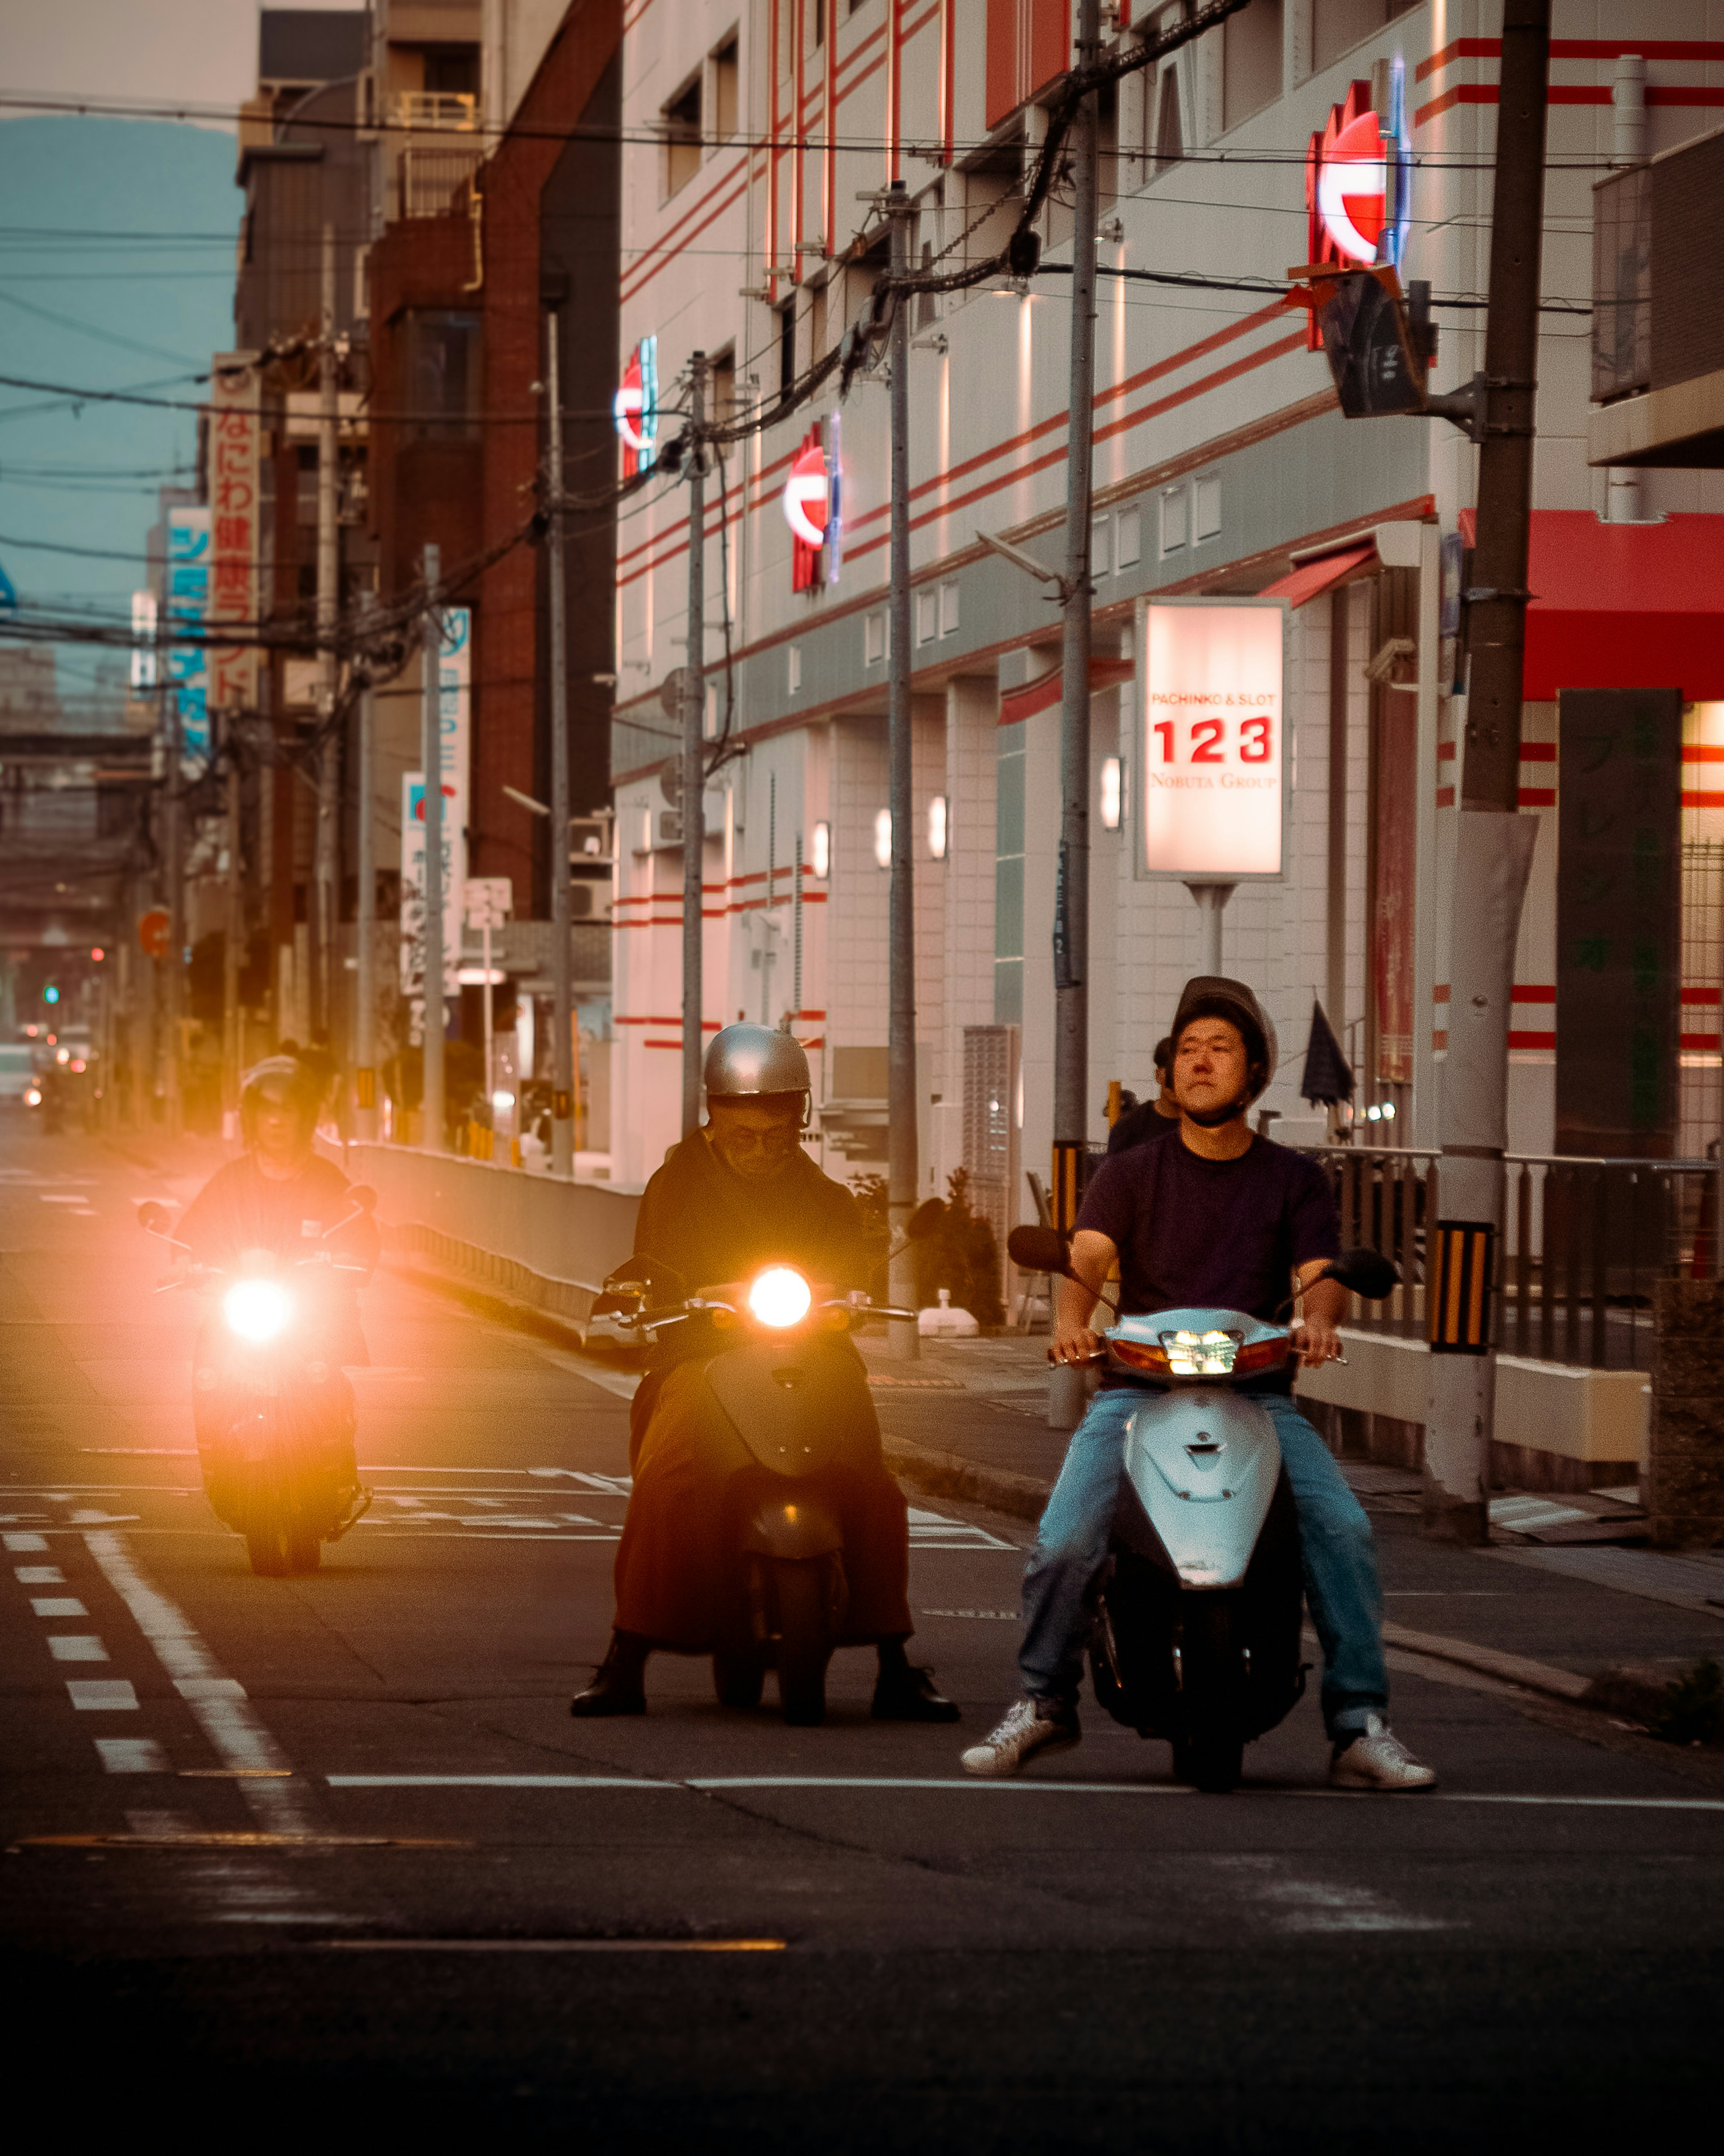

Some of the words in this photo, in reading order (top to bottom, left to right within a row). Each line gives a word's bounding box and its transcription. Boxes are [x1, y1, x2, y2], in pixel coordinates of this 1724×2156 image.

[1152, 694, 1221, 705] PACHINKO
[1226, 695, 1234, 705] &
[1239, 694, 1276, 705] SLOT
[1154, 715, 1272, 763] 123
